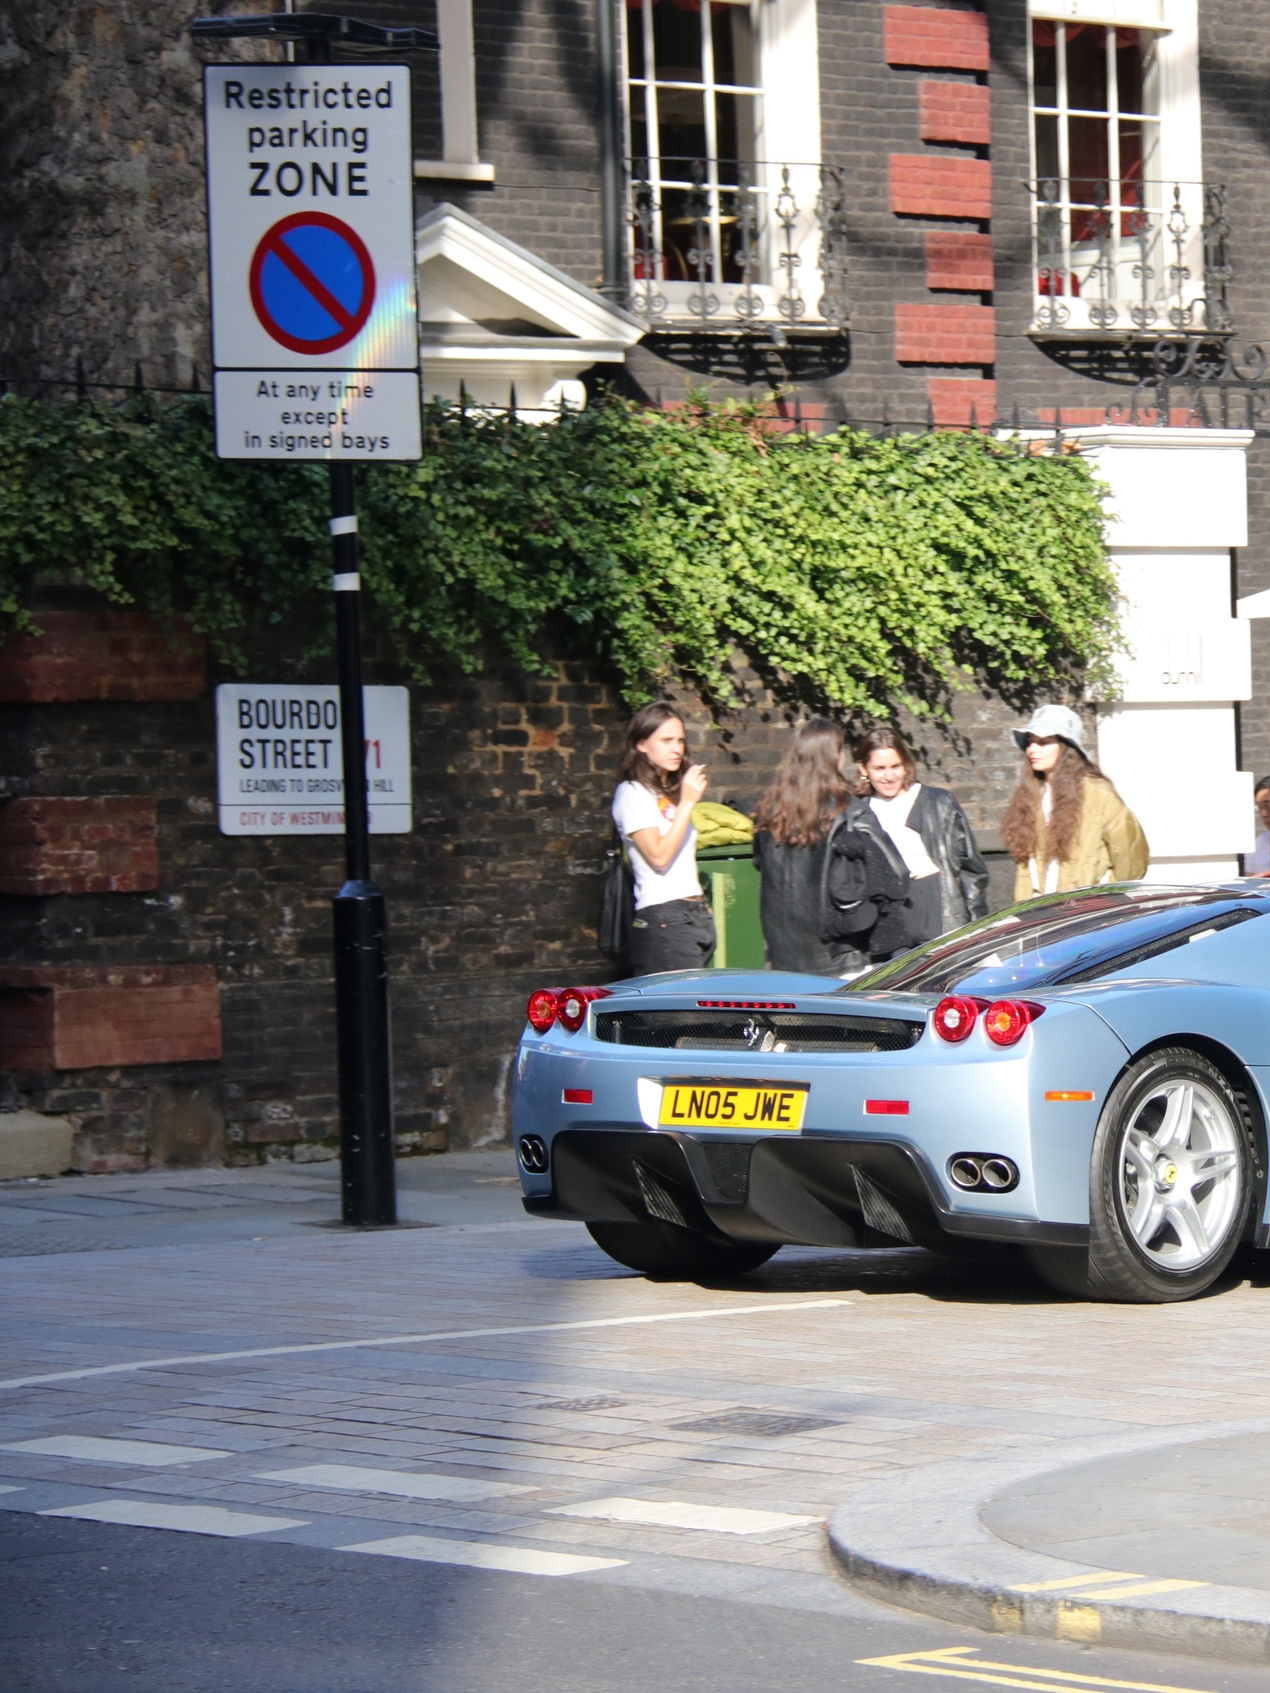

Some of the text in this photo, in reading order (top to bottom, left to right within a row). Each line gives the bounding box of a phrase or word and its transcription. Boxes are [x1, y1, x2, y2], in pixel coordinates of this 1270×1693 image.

[224, 80, 392, 109] Restricted
[248, 120, 369, 153] parking
[248, 161, 369, 197] ZONE
[256, 380, 374, 403] At any time
[281, 407, 349, 426] except
[244, 432, 390, 452] in signed bays
[237, 698, 338, 730] BOURDO
[239, 738, 333, 769] STREET
[240, 779, 287, 793] LEADING
[290, 779, 304, 793] TO
[373, 779, 394, 793] HILL
[239, 812, 267, 826] CITY
[271, 812, 287, 826] OF
[671, 1089, 795, 1122] LN05 JWE
